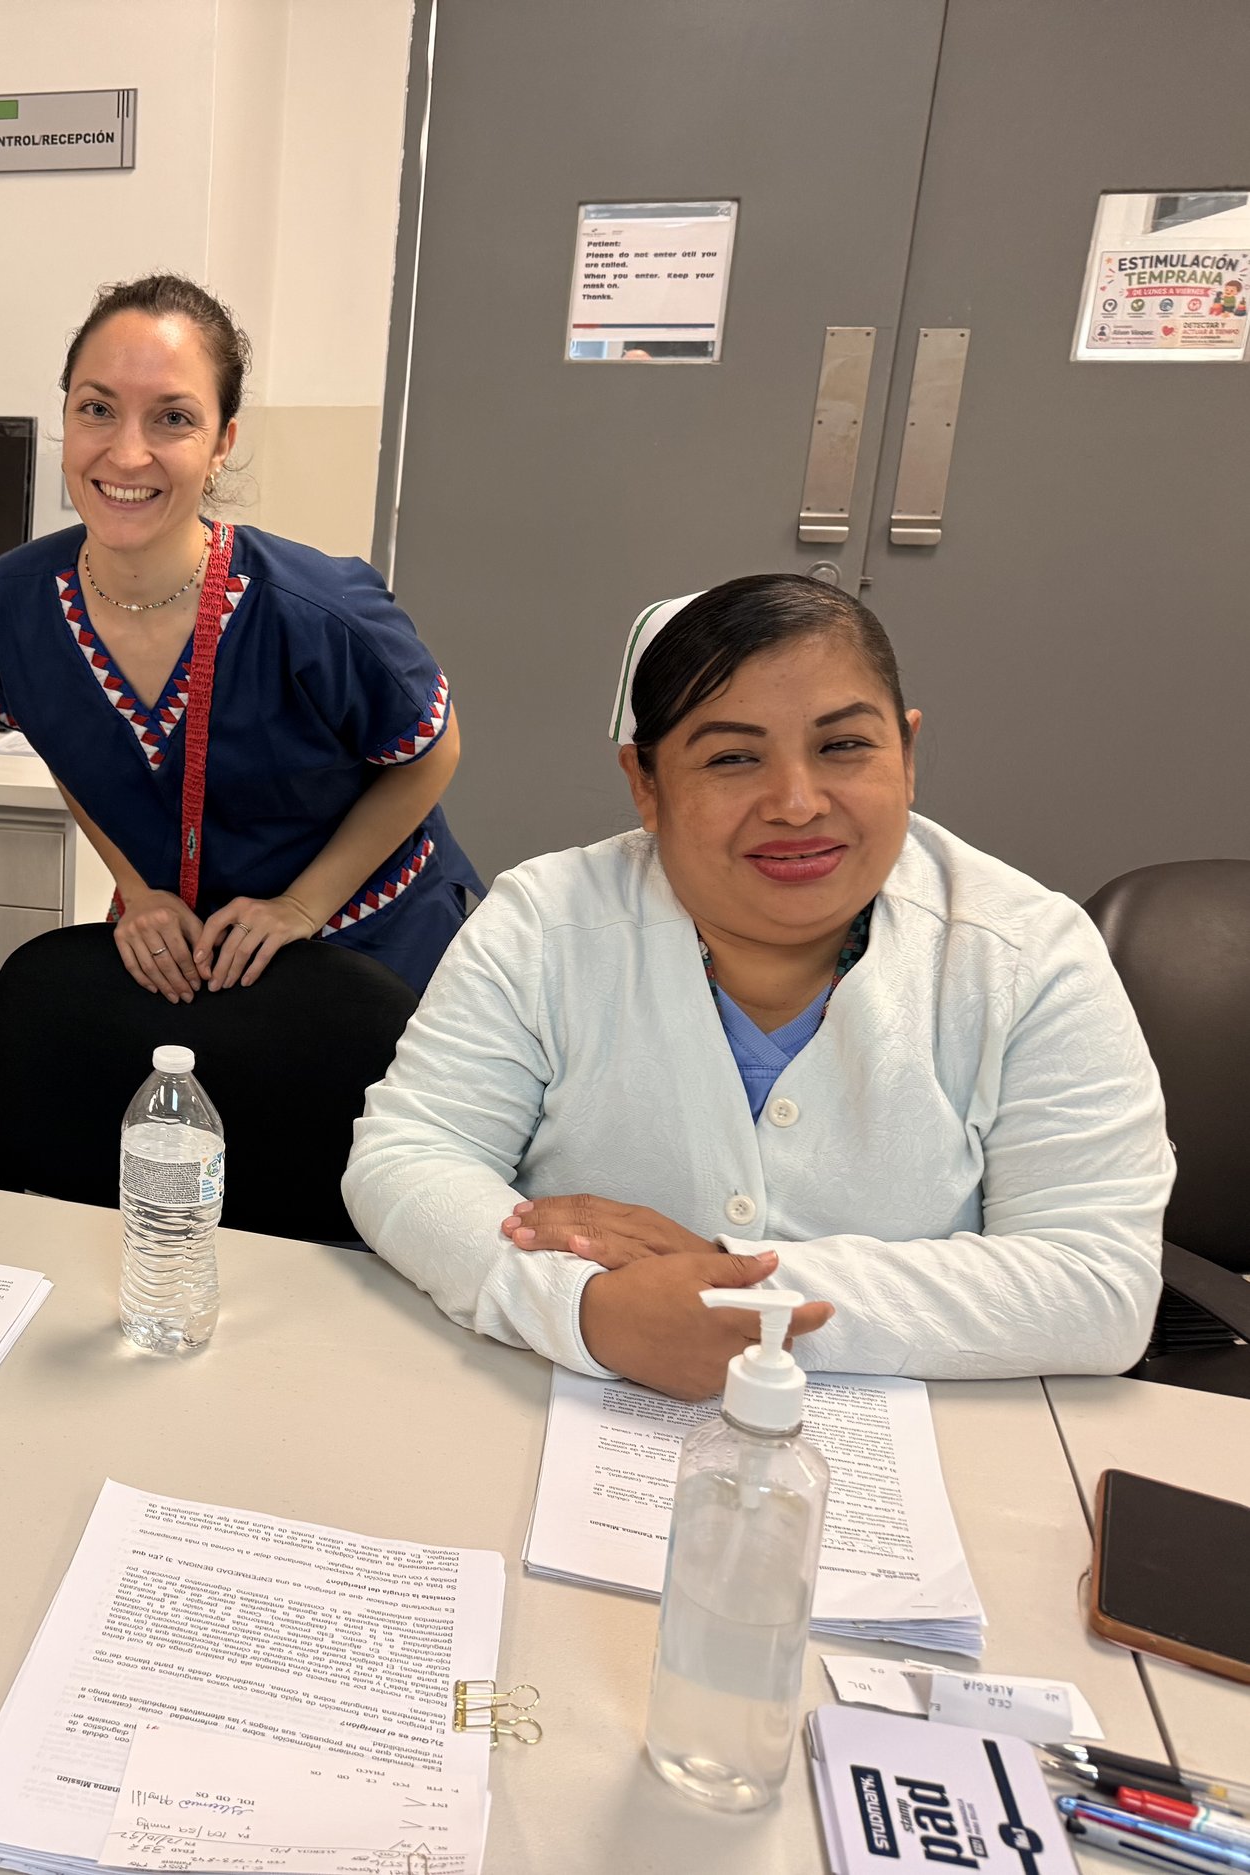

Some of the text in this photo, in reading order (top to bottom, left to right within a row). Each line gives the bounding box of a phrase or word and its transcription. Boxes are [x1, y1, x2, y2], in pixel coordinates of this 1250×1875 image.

[585, 251, 614, 259] Please
[701, 251, 717, 259] you
[1118, 253, 1239, 272] ESTIMULACIÓN
[666, 272, 689, 280] Keep
[695, 272, 715, 280] your
[1124, 269, 1223, 286] TEMPRANA
[56, 1774, 92, 1790] Mission
[195, 1791, 255, 1806] IOL OD OS
[893, 1775, 980, 1870] pad
[896, 1798, 915, 1833] stamp
